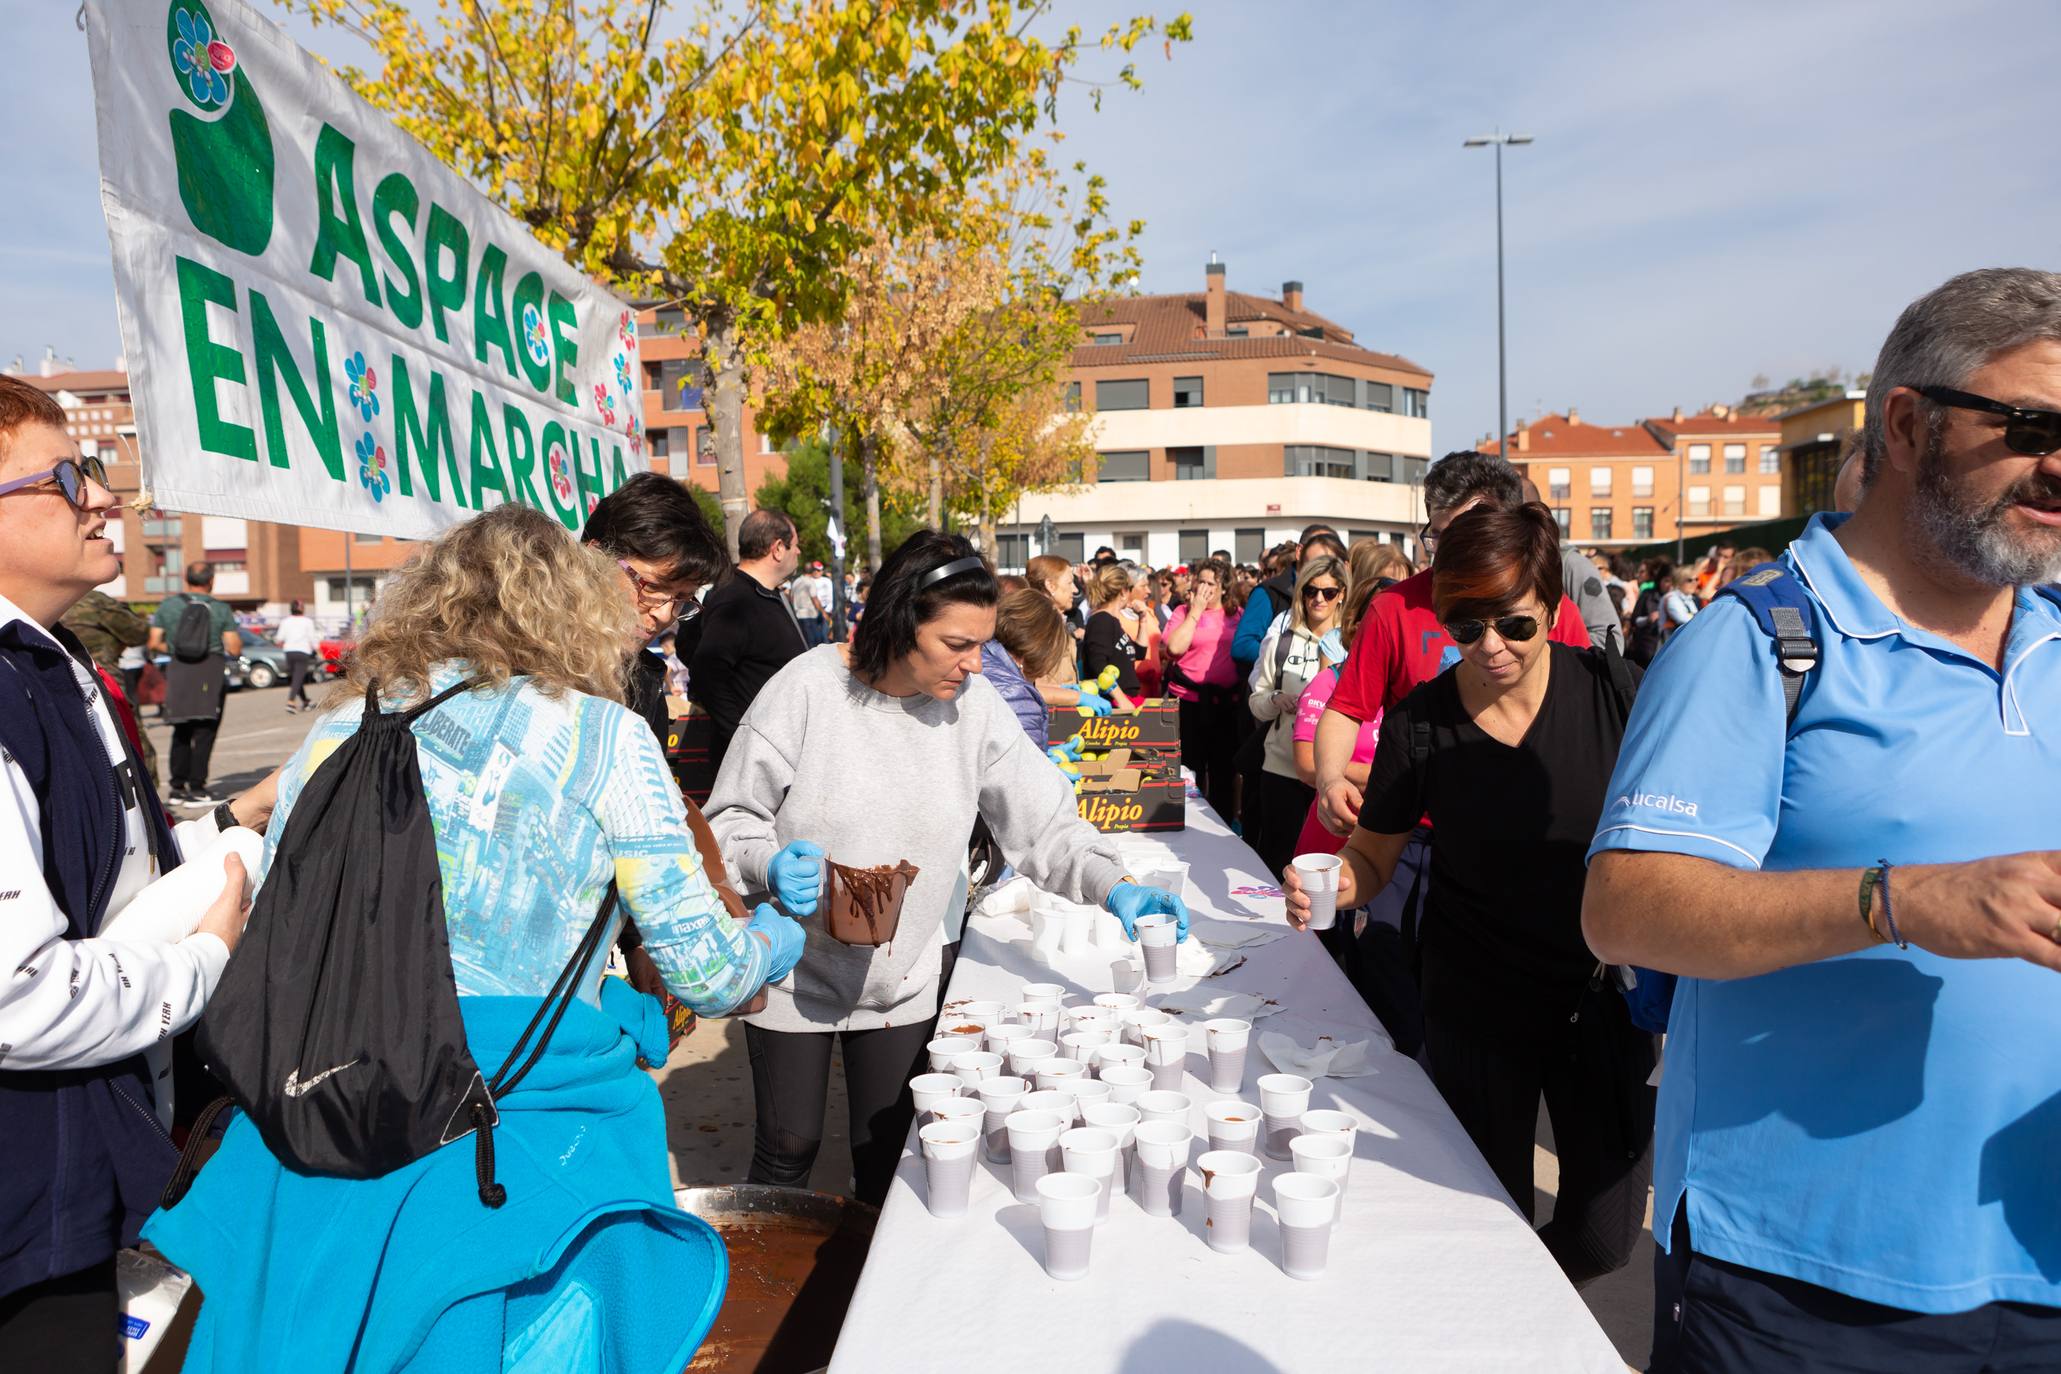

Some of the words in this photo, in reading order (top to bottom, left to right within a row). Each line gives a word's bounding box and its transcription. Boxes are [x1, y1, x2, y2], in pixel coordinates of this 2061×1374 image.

[310, 122, 579, 408] ASPACE
[176, 255, 346, 482] EN
[420, 709, 472, 756] LIBERATE
[1077, 717, 1140, 746] Alipio
[1077, 796, 1143, 830] Alipio
[161, 1001, 172, 1026] YEAH
